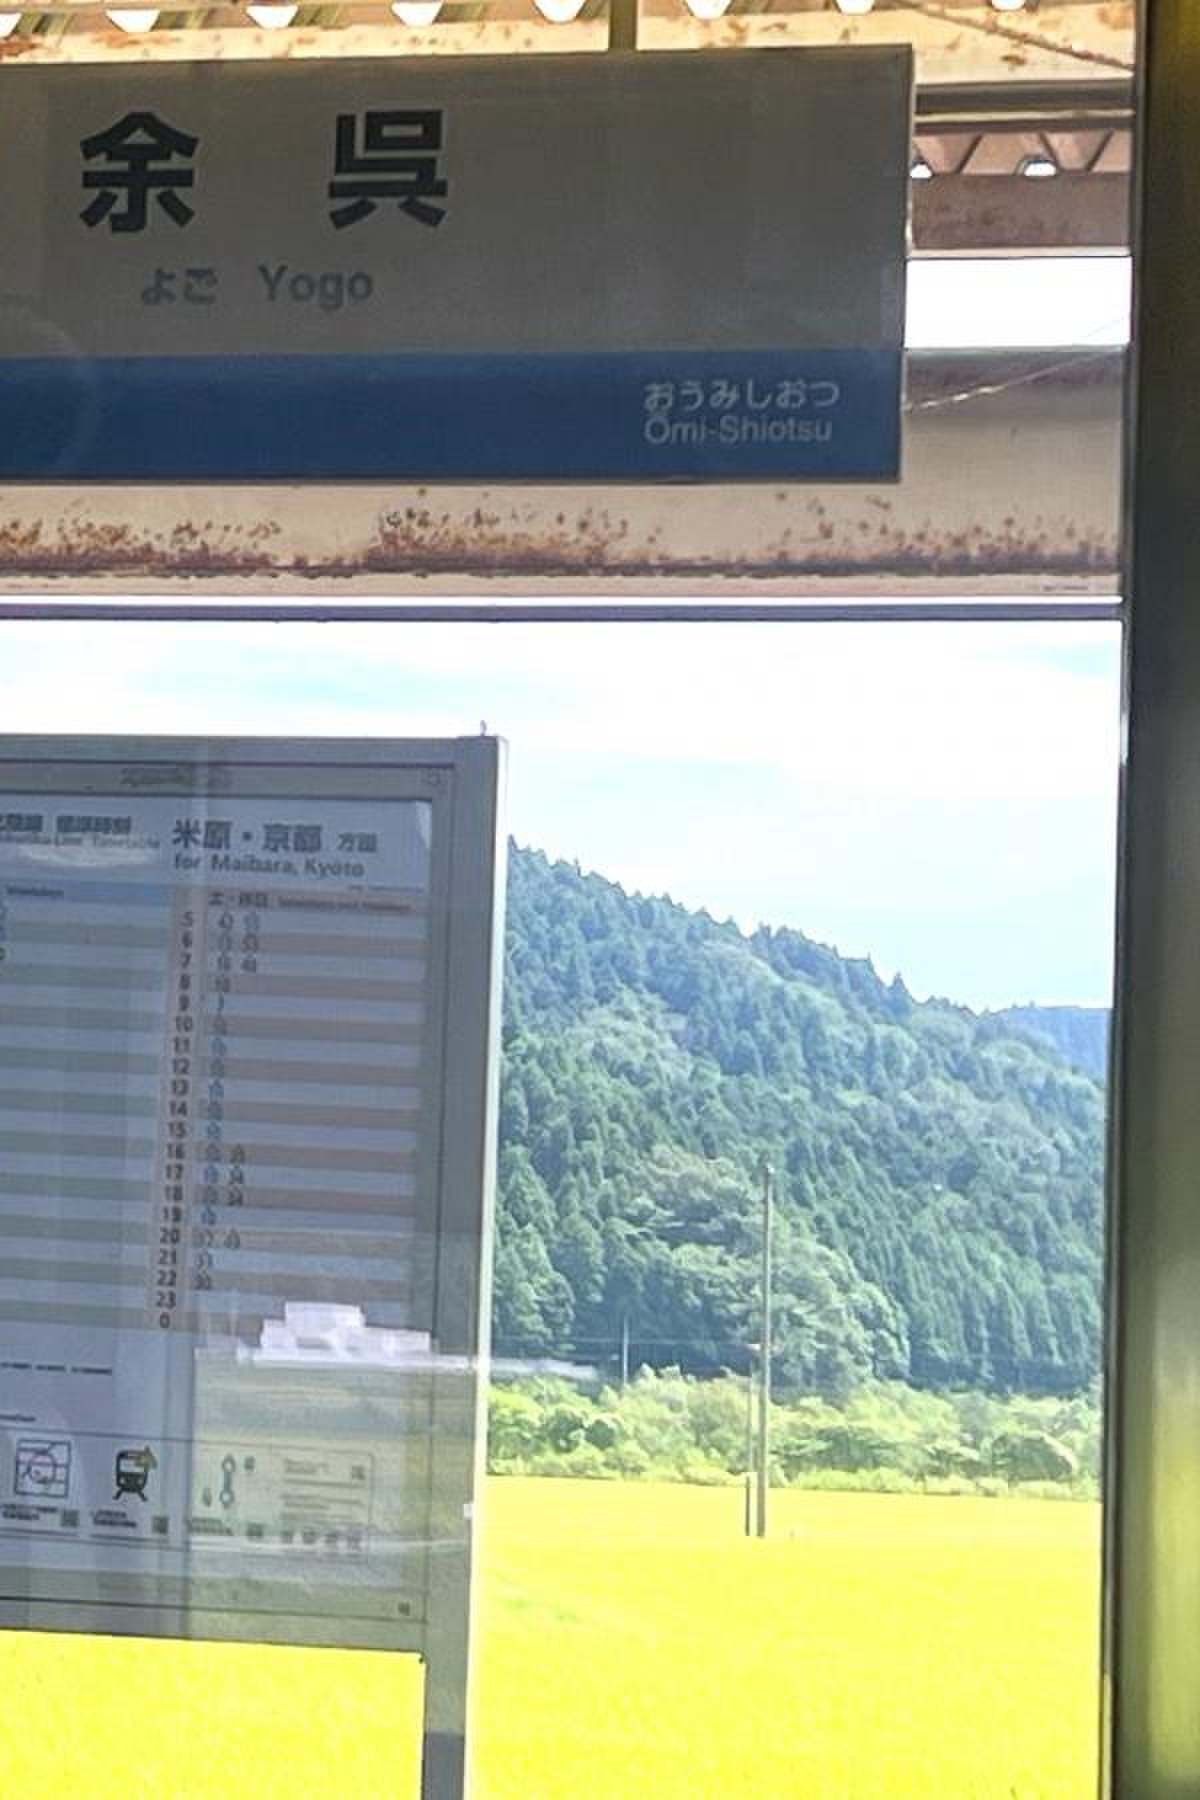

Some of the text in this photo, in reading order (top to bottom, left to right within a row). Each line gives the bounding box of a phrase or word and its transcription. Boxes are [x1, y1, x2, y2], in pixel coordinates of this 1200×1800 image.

[79, 109, 450, 233] 余呉
[140, 263, 375, 311] よご Yogo
[644, 378, 841, 412] おうみしおつ
[174, 853, 201, 871] for
[303, 859, 366, 879] Kyoto
